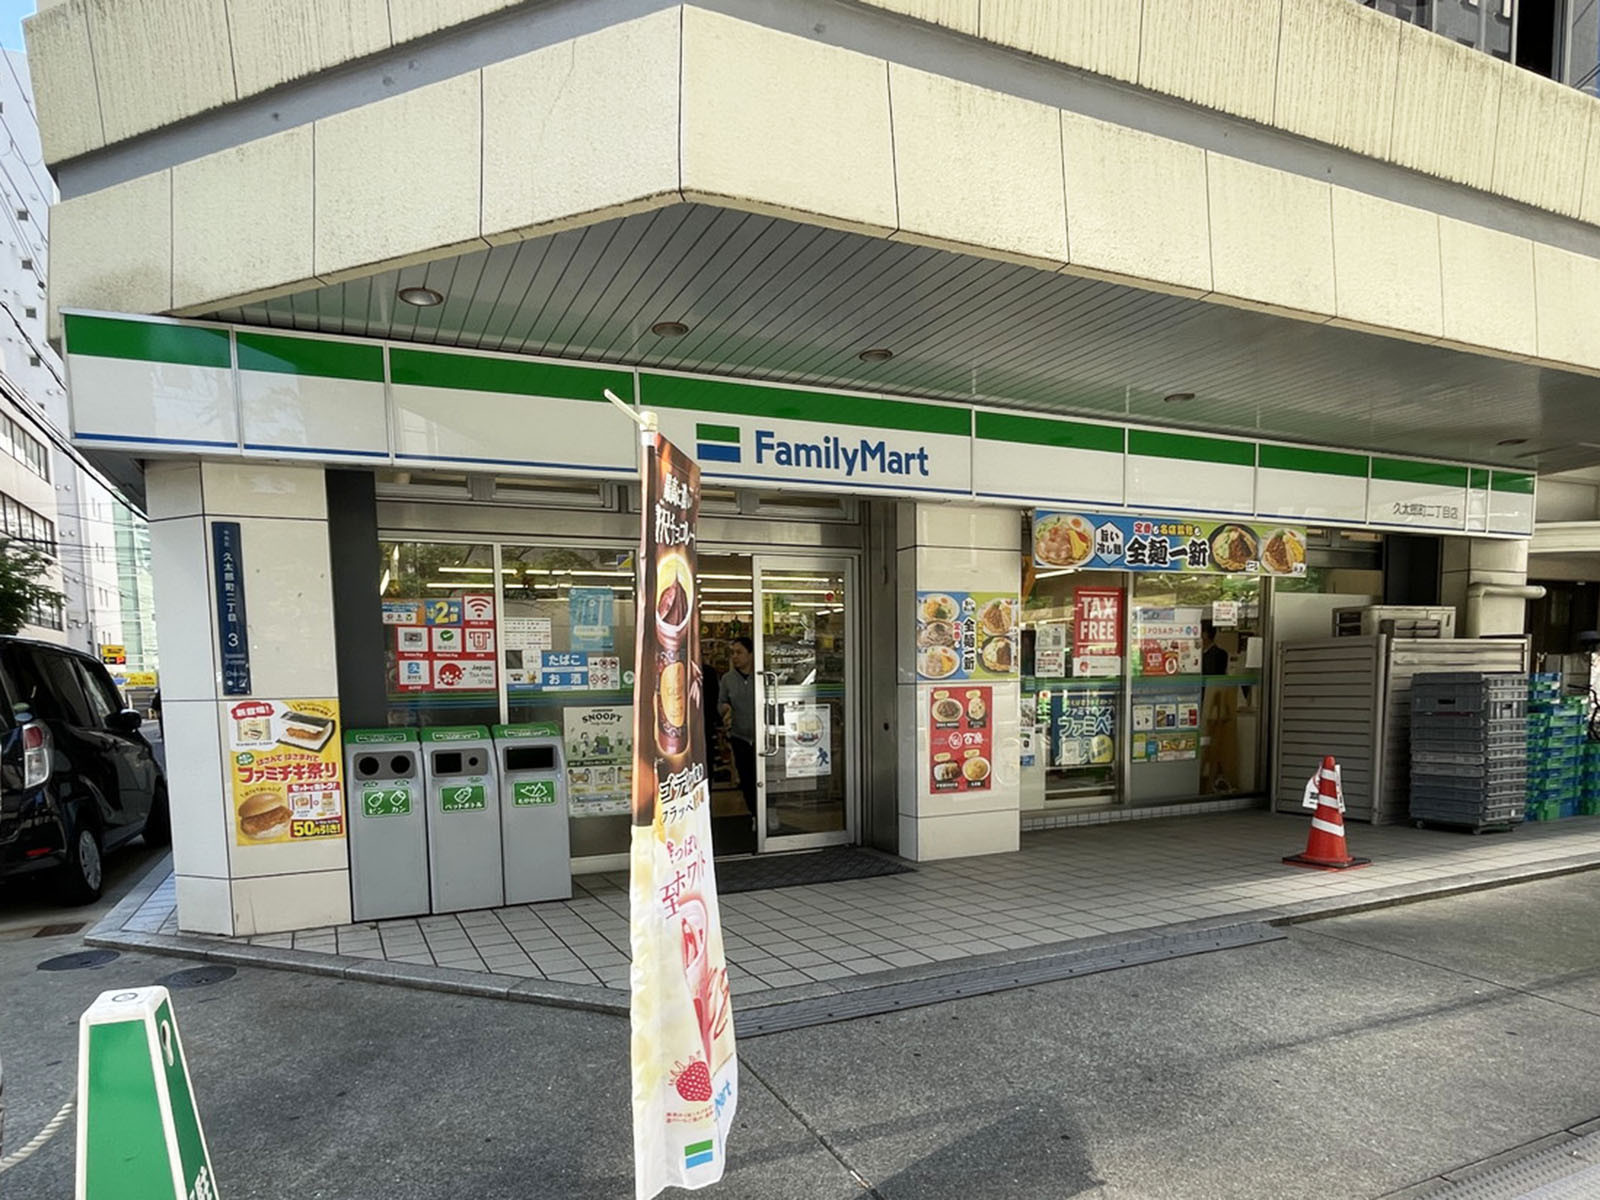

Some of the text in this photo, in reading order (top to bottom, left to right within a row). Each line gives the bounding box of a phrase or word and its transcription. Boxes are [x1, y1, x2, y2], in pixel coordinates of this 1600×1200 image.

[755, 430, 929, 477] FamilyMart
[1392, 502, 1459, 519] 久太郎町二丁目店
[1101, 529, 1120, 542] 旨い
[1126, 537, 1208, 567] 全麺一新
[1080, 597, 1116, 619] TAX
[228, 632, 239, 647] 3
[1080, 621, 1115, 640] FREE
[548, 654, 581, 666] たばこ
[582, 713, 623, 723] SNOOPY
[238, 762, 338, 784] ファミチキ祭り
